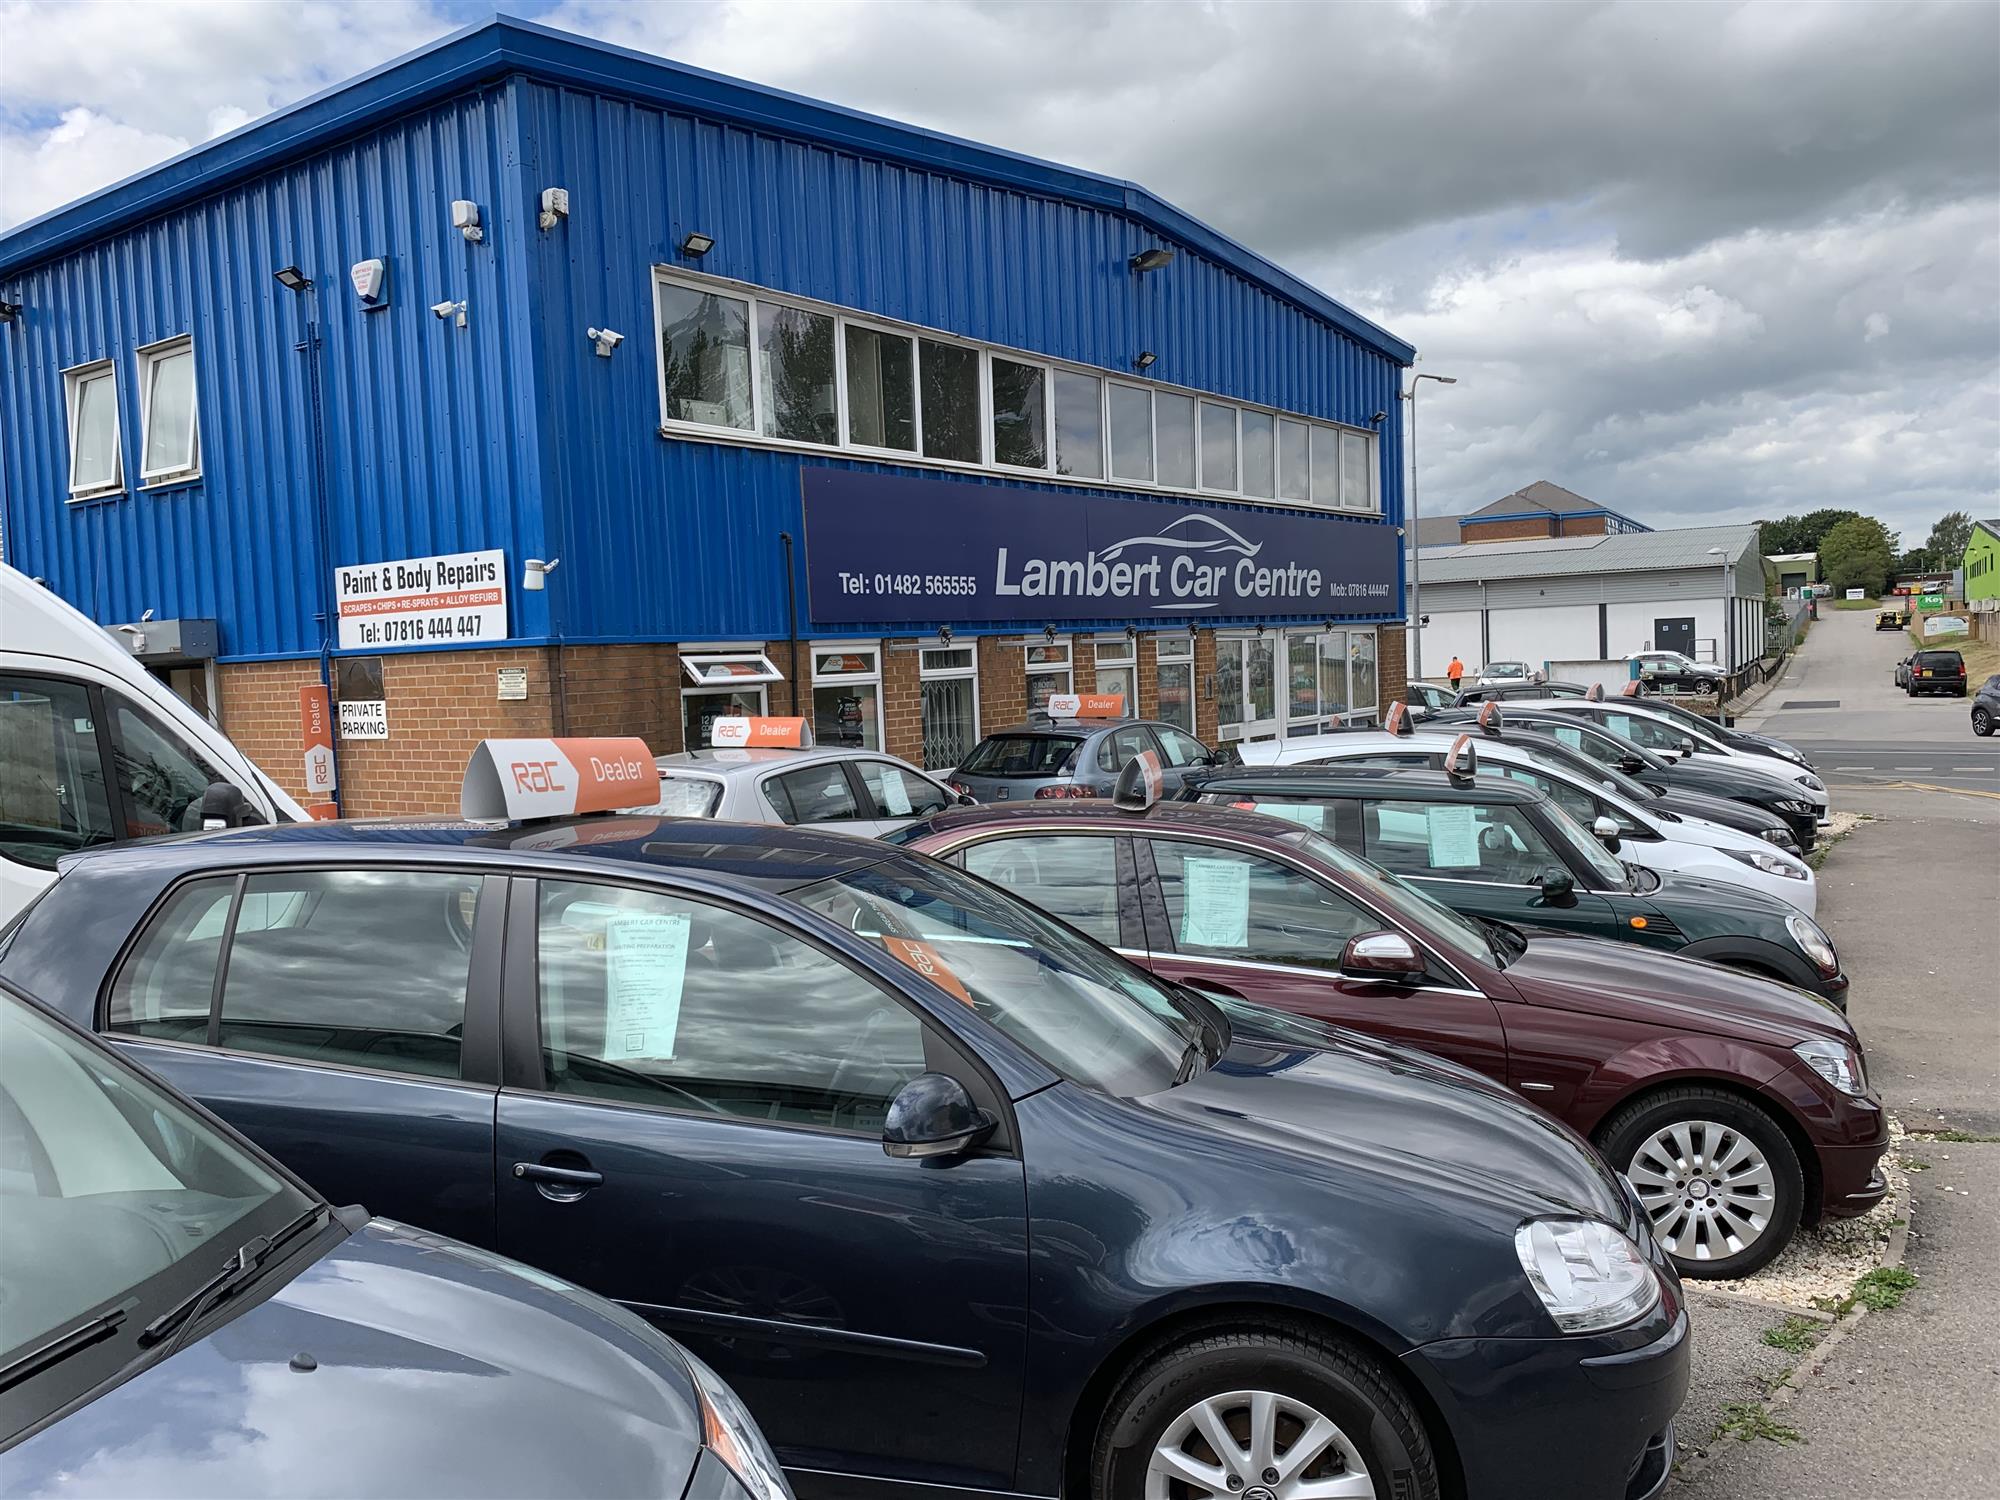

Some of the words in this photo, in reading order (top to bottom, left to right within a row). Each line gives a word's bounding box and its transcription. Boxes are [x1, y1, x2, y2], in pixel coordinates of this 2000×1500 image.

[343, 569, 377, 595] Paint
[382, 567, 393, 591] &
[397, 563, 432, 593] Body
[437, 557, 496, 590] Repairs
[839, 572, 870, 594] Tel:
[874, 573, 921, 595] 01482
[925, 575, 977, 595] 565555
[996, 547, 1161, 598] Lambert
[1170, 555, 1226, 598] Car
[1234, 557, 1322, 598] Centre
[1330, 582, 1347, 597] Mob:
[1348, 583, 1367, 597] 07816
[343, 602, 372, 614] SCRAPES
[377, 601, 396, 611] CHIPS
[401, 597, 439, 609] RE-SPRAYS
[445, 594, 468, 605] ALLOY
[469, 591, 498, 603] REFURB
[359, 623, 380, 644] Tel:
[384, 618, 423, 642] 07816
[428, 616, 453, 639] 444
[457, 614, 481, 637] 447
[309, 697, 321, 734] Dealer
[342, 703, 382, 717] PRIVATE
[1088, 699, 1114, 709] Dealer
[342, 721, 386, 735] PARKING
[760, 724, 792, 736] Dealer
[590, 752, 645, 783] Dealer
